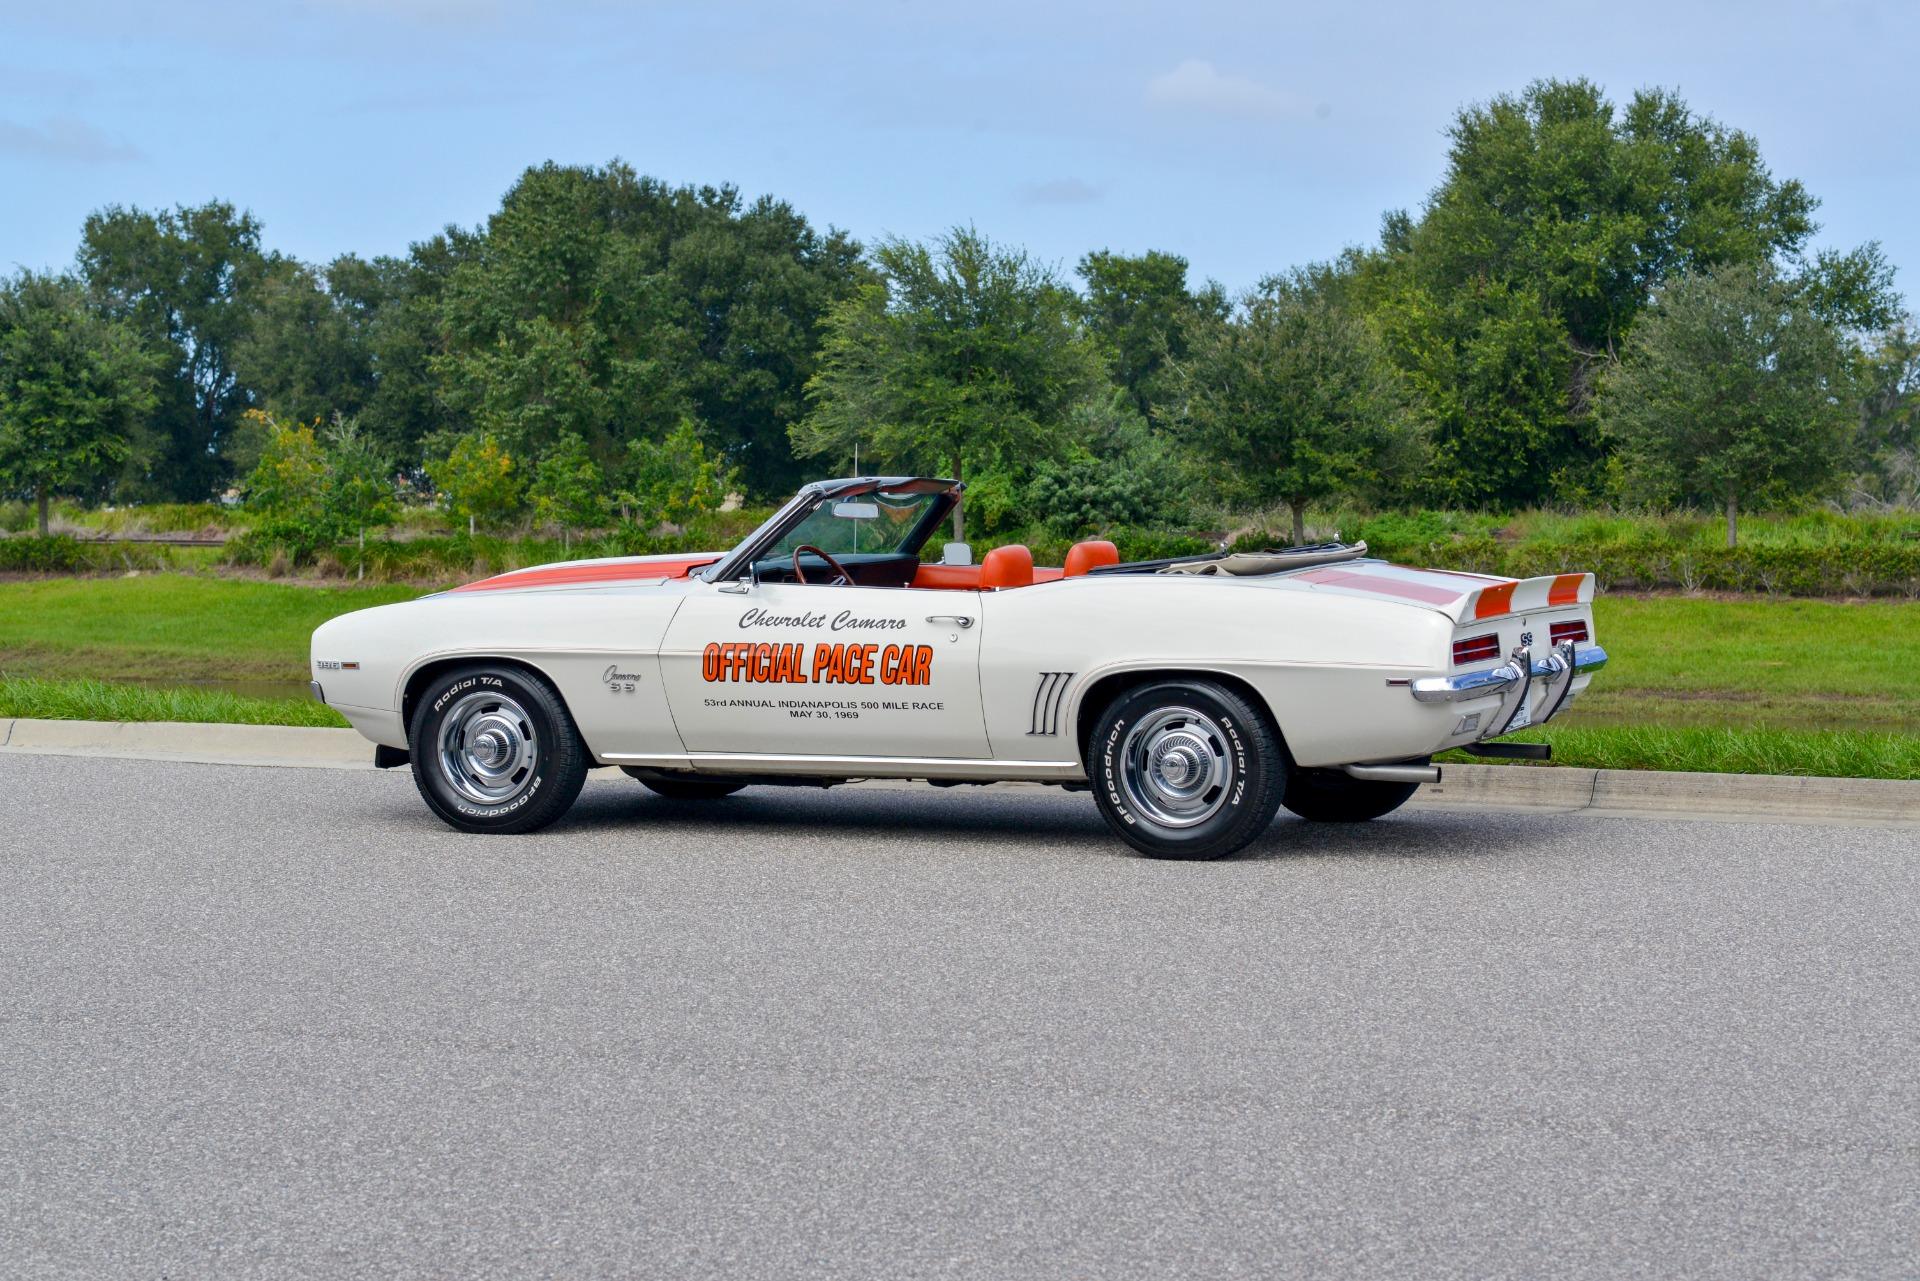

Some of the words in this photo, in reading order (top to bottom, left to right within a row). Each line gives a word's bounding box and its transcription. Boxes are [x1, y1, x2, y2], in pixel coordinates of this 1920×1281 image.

[738, 608, 825, 629] Chevrolet
[830, 610, 907, 631] Camaro
[702, 642, 807, 683] OFFICIAL
[812, 643, 878, 684] PACE
[880, 644, 933, 685] CAR
[434, 677, 476, 712] Radial
[480, 677, 503, 688] T/A
[704, 698, 727, 707] 53rd
[729, 700, 776, 708] ANNUAL
[778, 700, 857, 709] INDIANAPOLIS
[860, 701, 880, 710] 500
[882, 701, 910, 710] MILE
[912, 702, 945, 711] RACE
[789, 710, 813, 719] MAY
[816, 710, 832, 720] 30,
[834, 711, 860, 719] 1969
[1220, 716, 1246, 774] Radial
[1104, 719, 1136, 825] BFGoodrich
[457, 776, 542, 817] BFGoodrich
[1231, 779, 1245, 806] T/A
